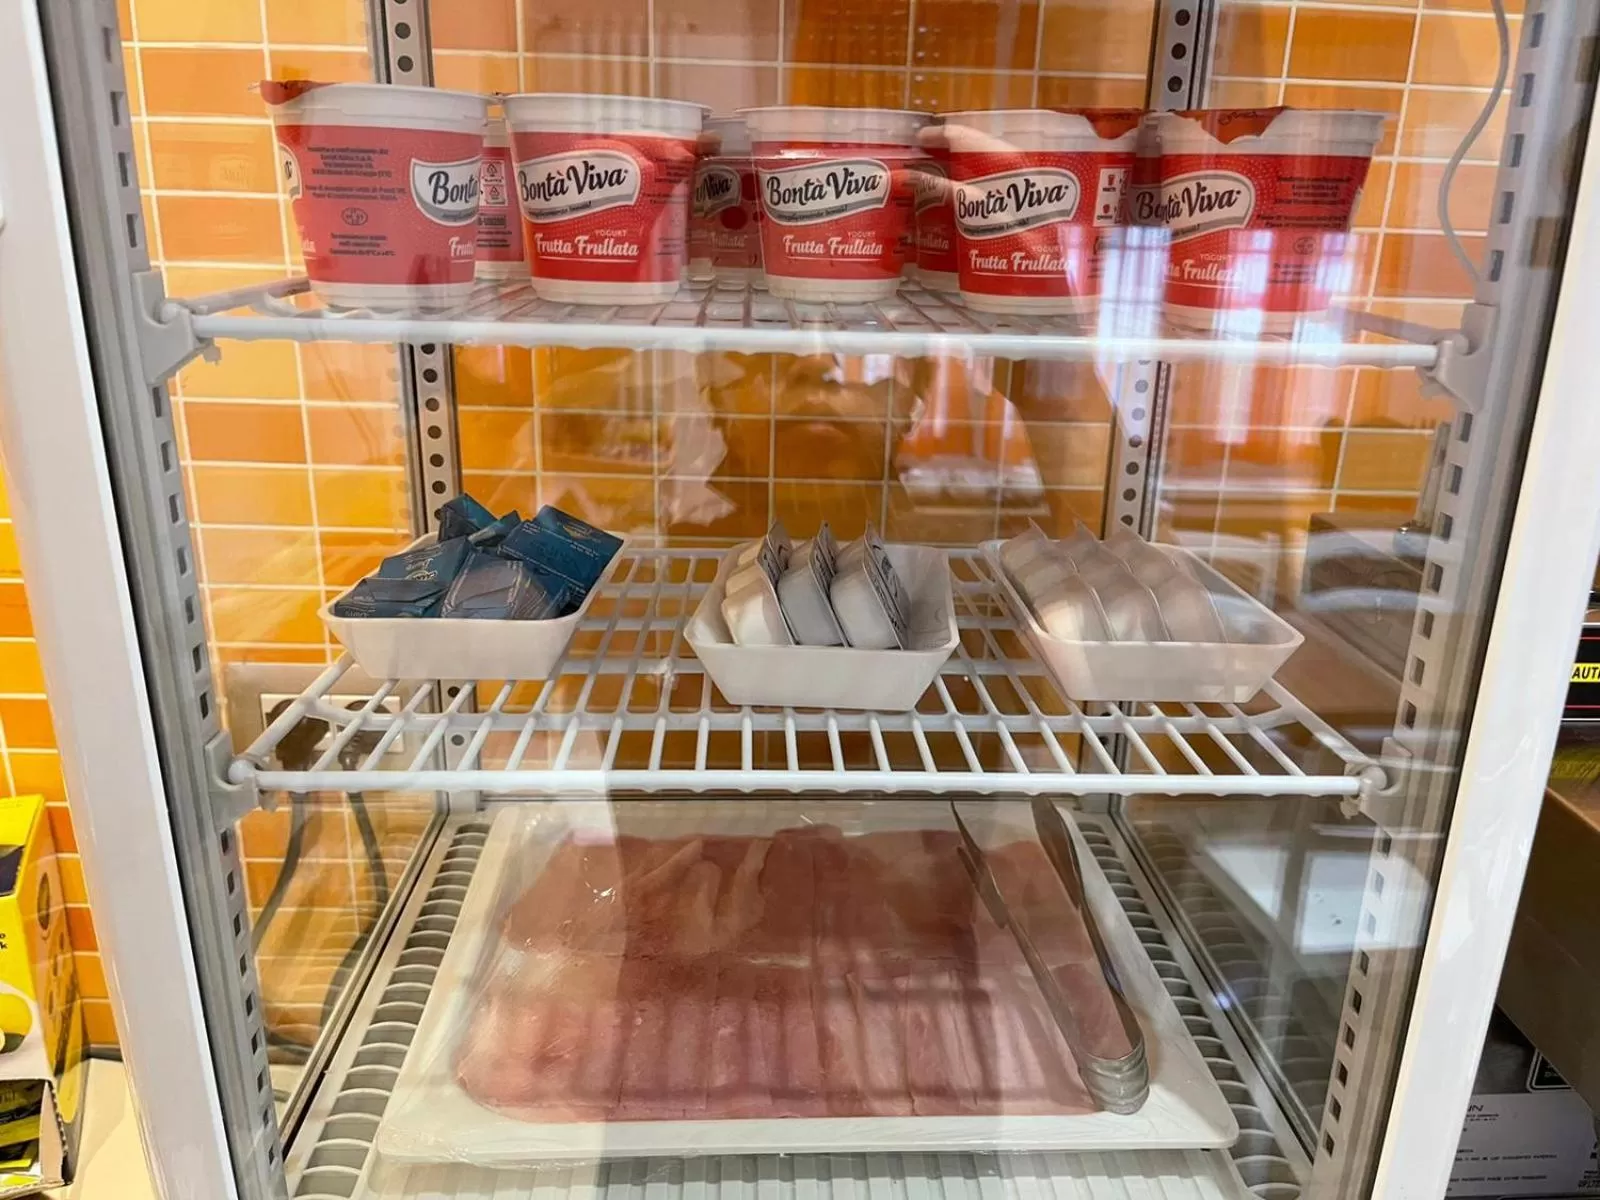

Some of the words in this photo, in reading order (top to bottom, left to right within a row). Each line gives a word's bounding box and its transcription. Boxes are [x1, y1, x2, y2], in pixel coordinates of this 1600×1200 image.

[519, 170, 569, 202] Bontà
[566, 160, 628, 195] Viva
[766, 176, 827, 207] Bontà
[826, 167, 882, 200] Viva
[956, 188, 1008, 219] Bontà
[1007, 178, 1069, 212] Viva
[1182, 181, 1241, 218] Viva
[534, 232, 573, 254] Frutta
[574, 234, 640, 256] Frullata
[595, 229, 627, 237] YOGURT
[782, 234, 825, 254] Frutta
[827, 236, 883, 255] Frullata
[969, 249, 1008, 271] Frutta
